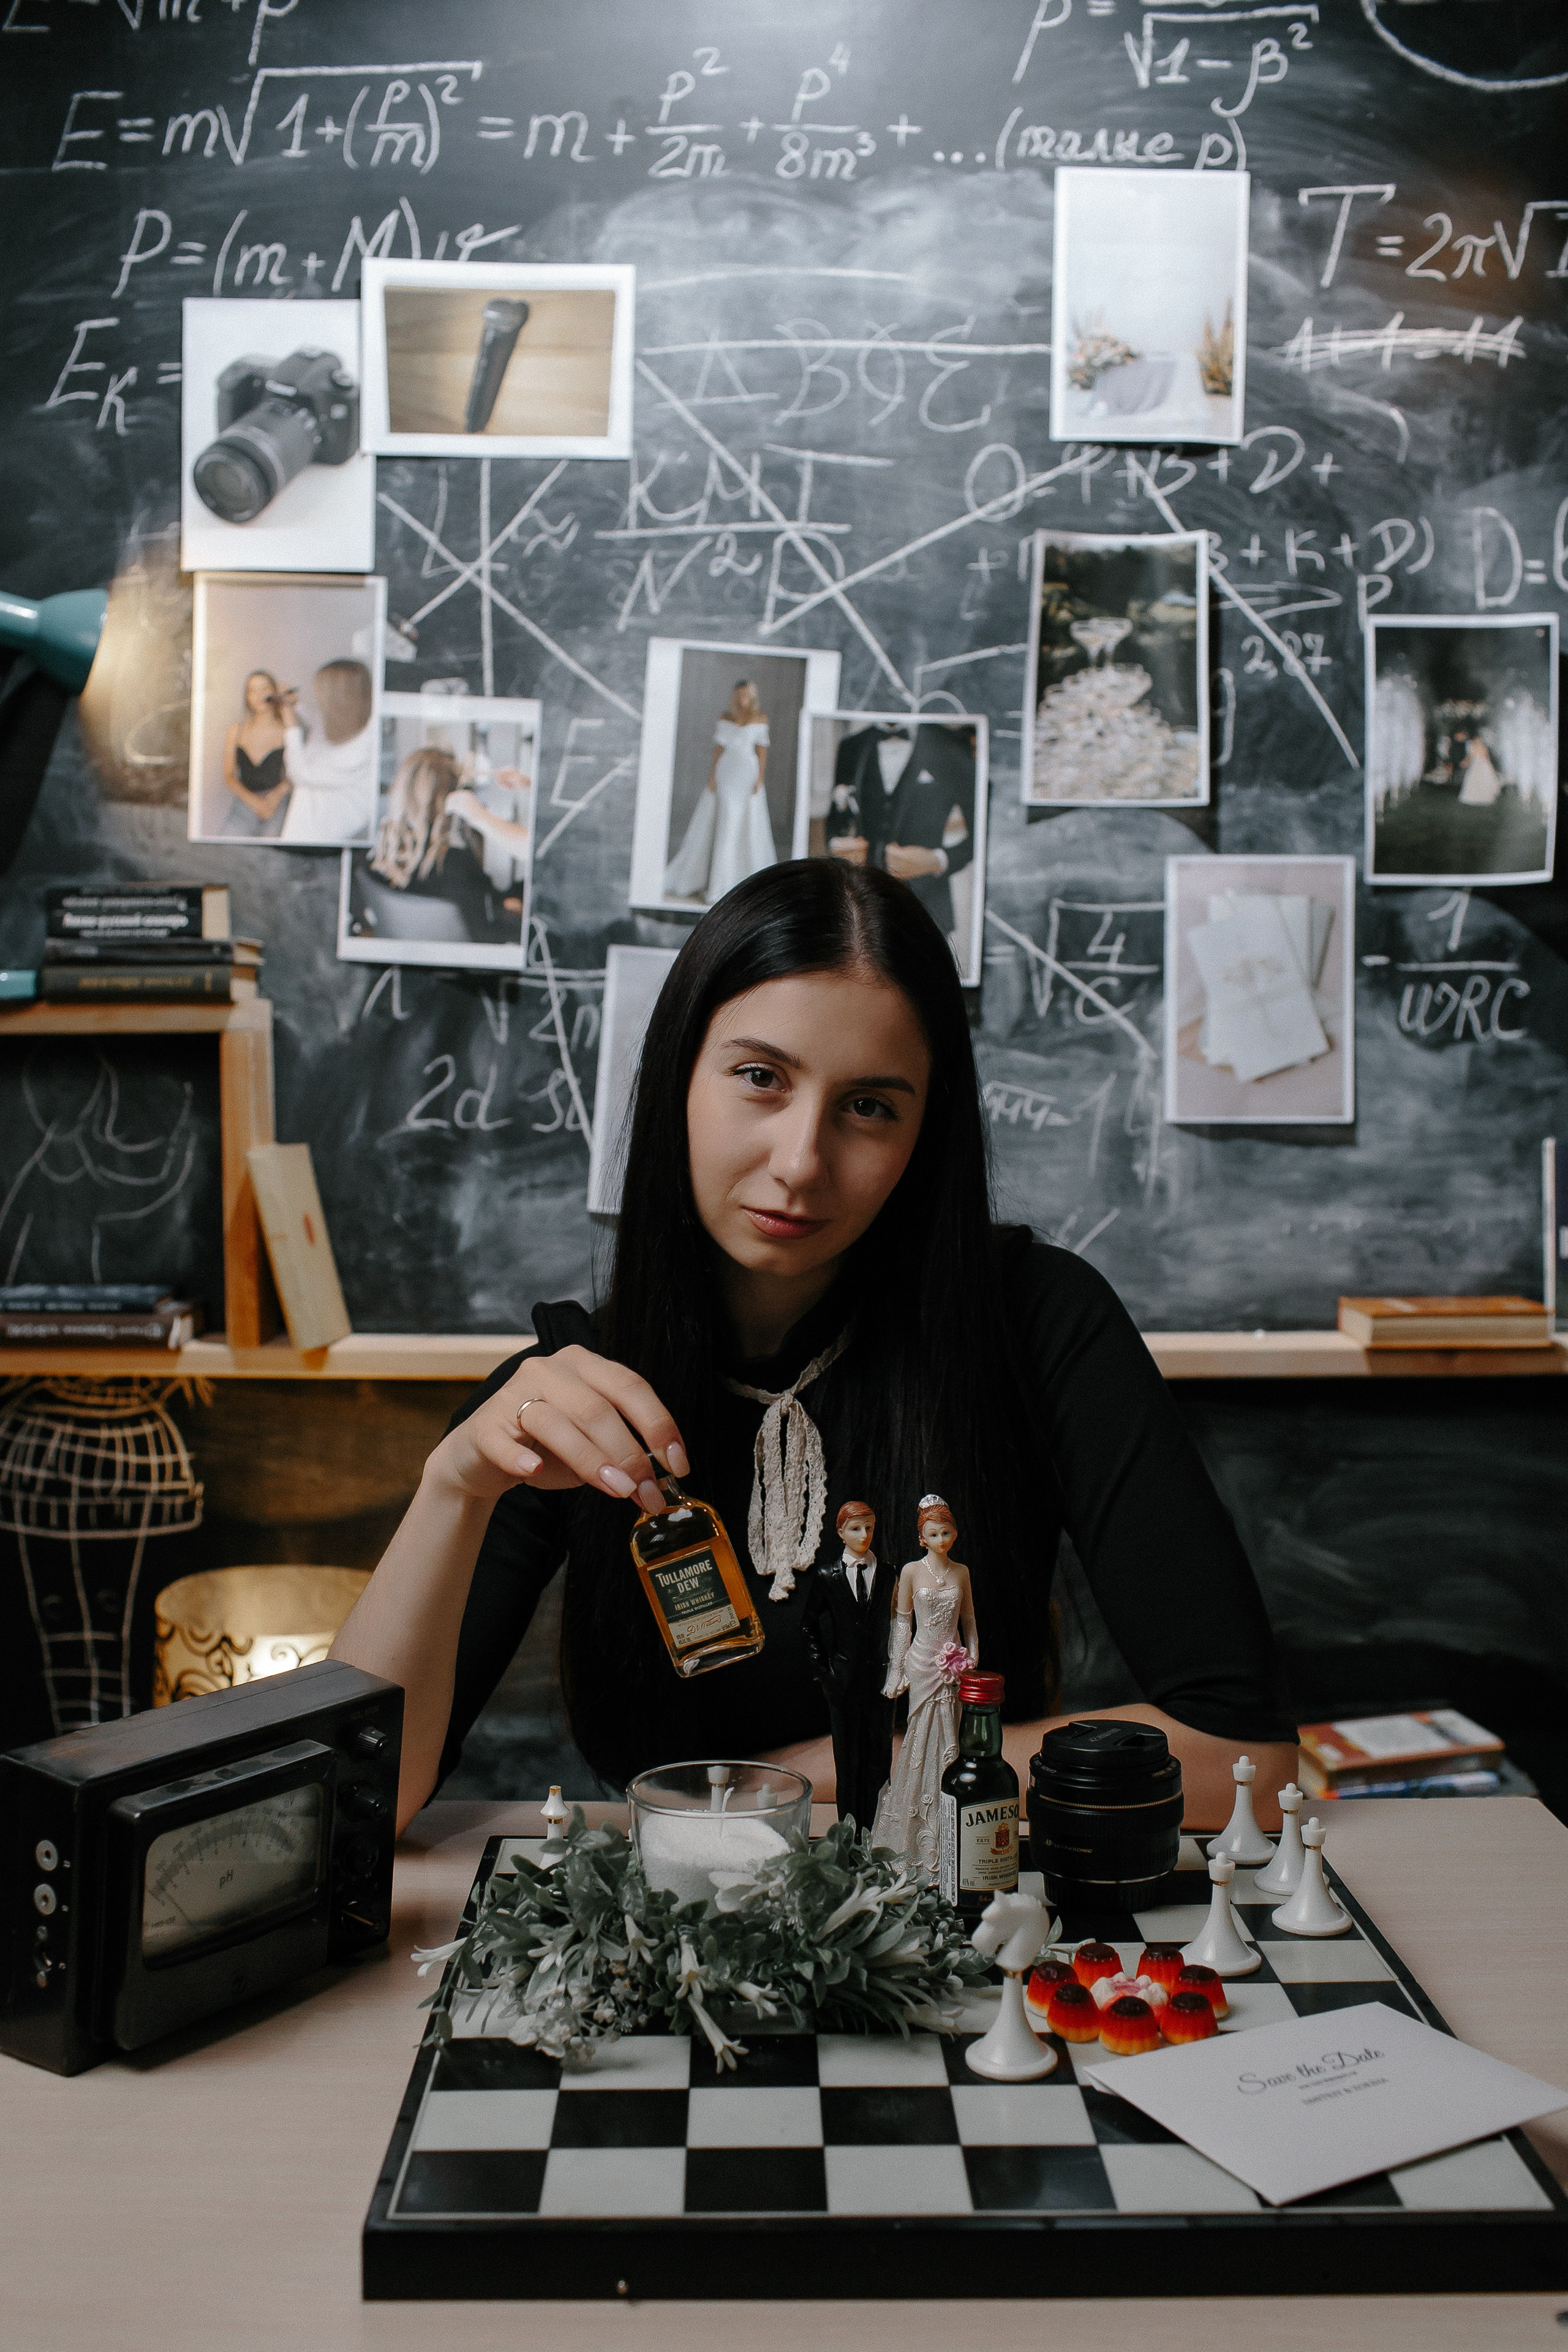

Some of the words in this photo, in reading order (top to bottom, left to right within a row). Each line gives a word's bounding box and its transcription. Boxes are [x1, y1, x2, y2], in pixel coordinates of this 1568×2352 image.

[655, 1559, 712, 1587] TULLAMORE
[677, 1577, 699, 1594] DEW
[674, 1601, 690, 1611] IRISH
[690, 1592, 715, 1606] WHISKEY
[1054, 1843, 1093, 1853] ULTRASONIC
[1238, 2071, 1297, 2094] Save
[1295, 2064, 1327, 2078] the
[1322, 2048, 1386, 2070] Date
